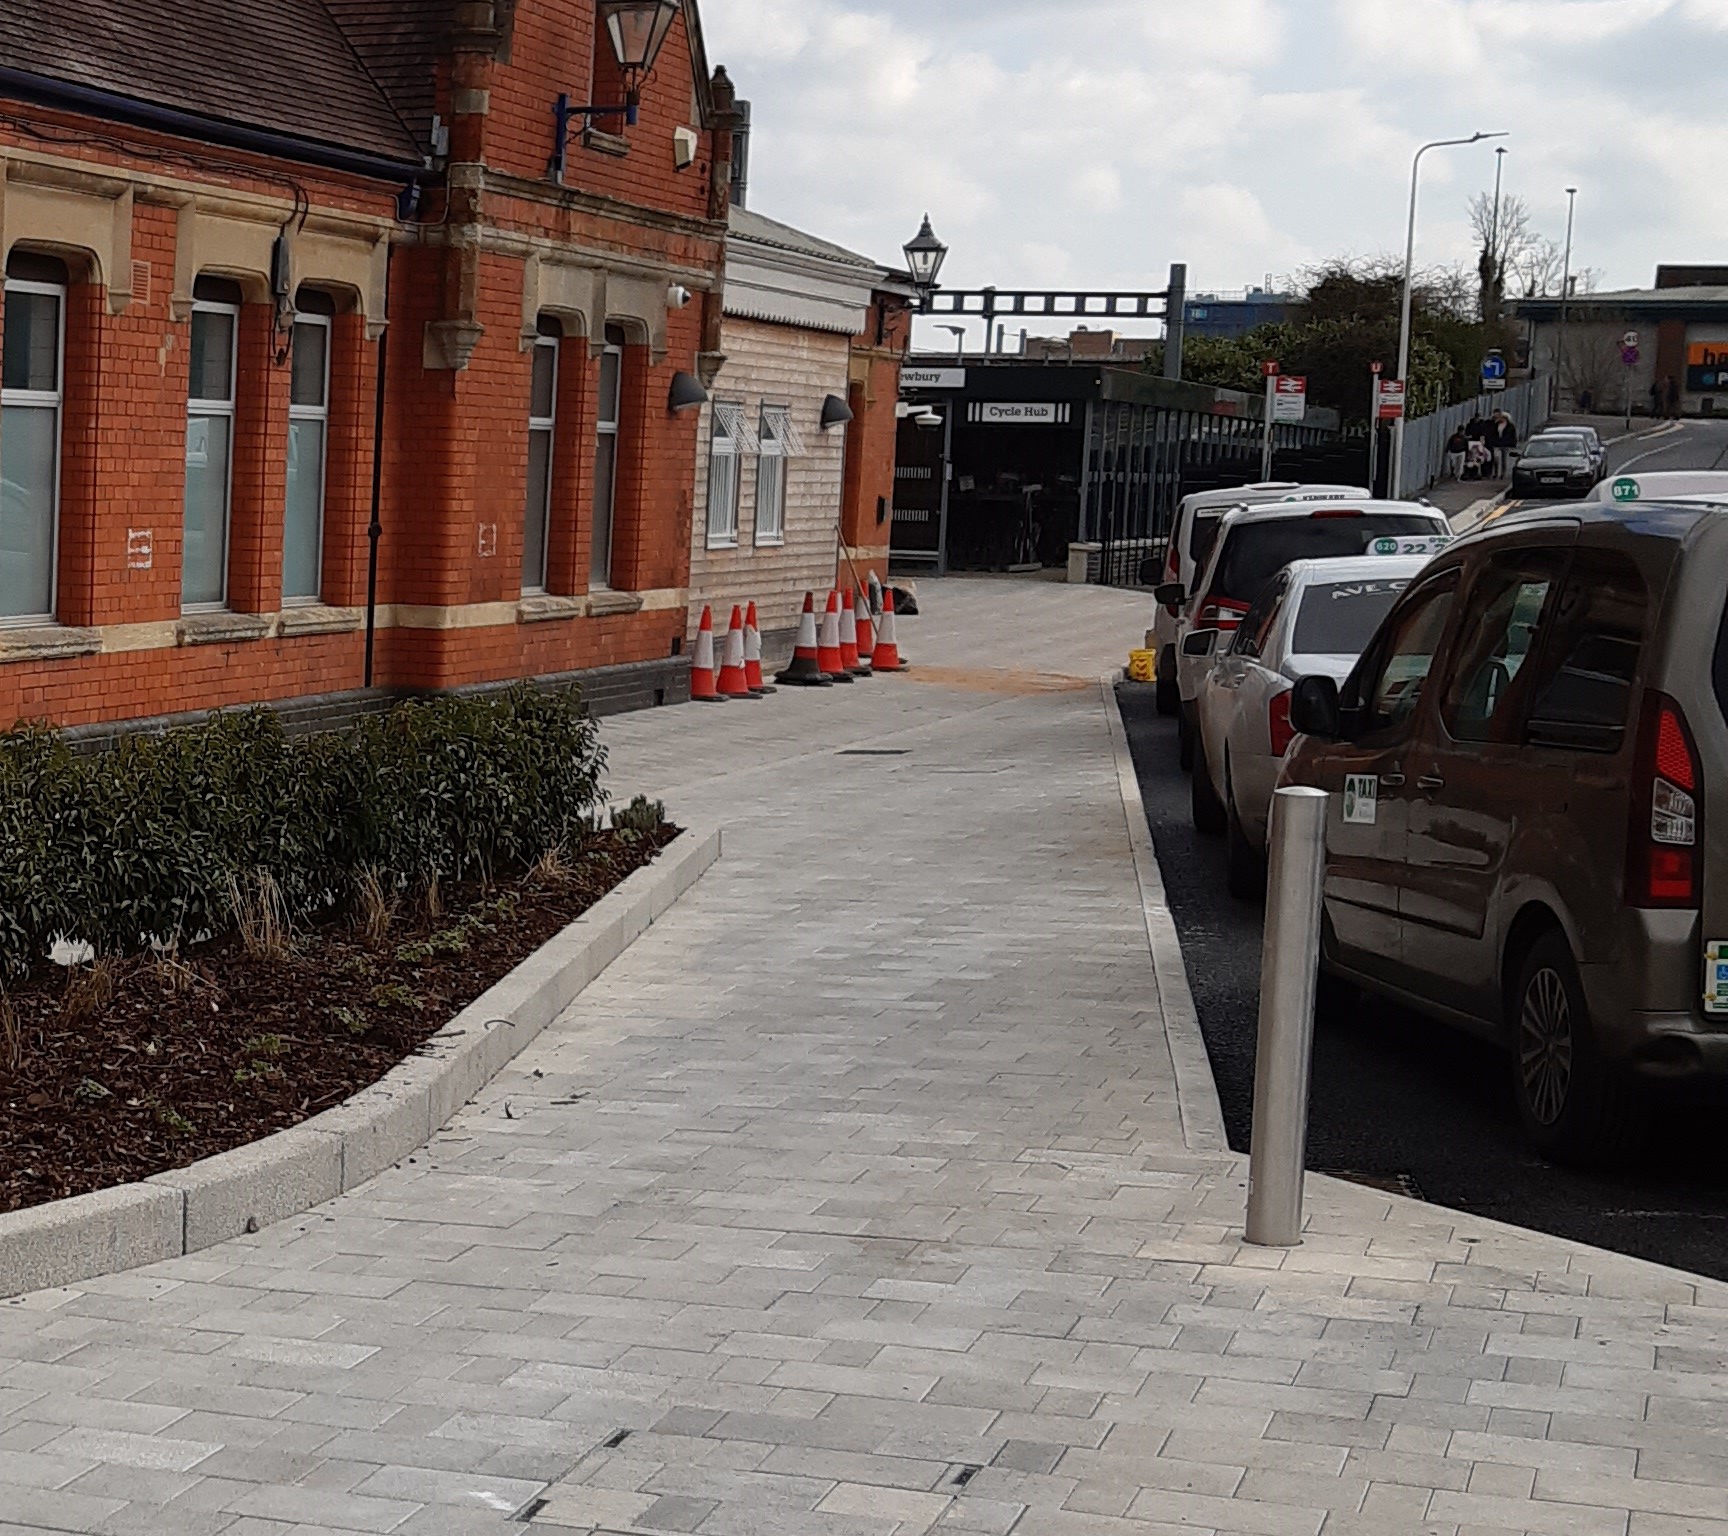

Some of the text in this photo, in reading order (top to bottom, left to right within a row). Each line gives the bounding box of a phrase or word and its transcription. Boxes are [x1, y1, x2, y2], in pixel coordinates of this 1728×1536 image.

[989, 406, 1048, 418] Cycle Hub
[1403, 543, 1427, 554] 22
[1359, 778, 1377, 799] TAXI
